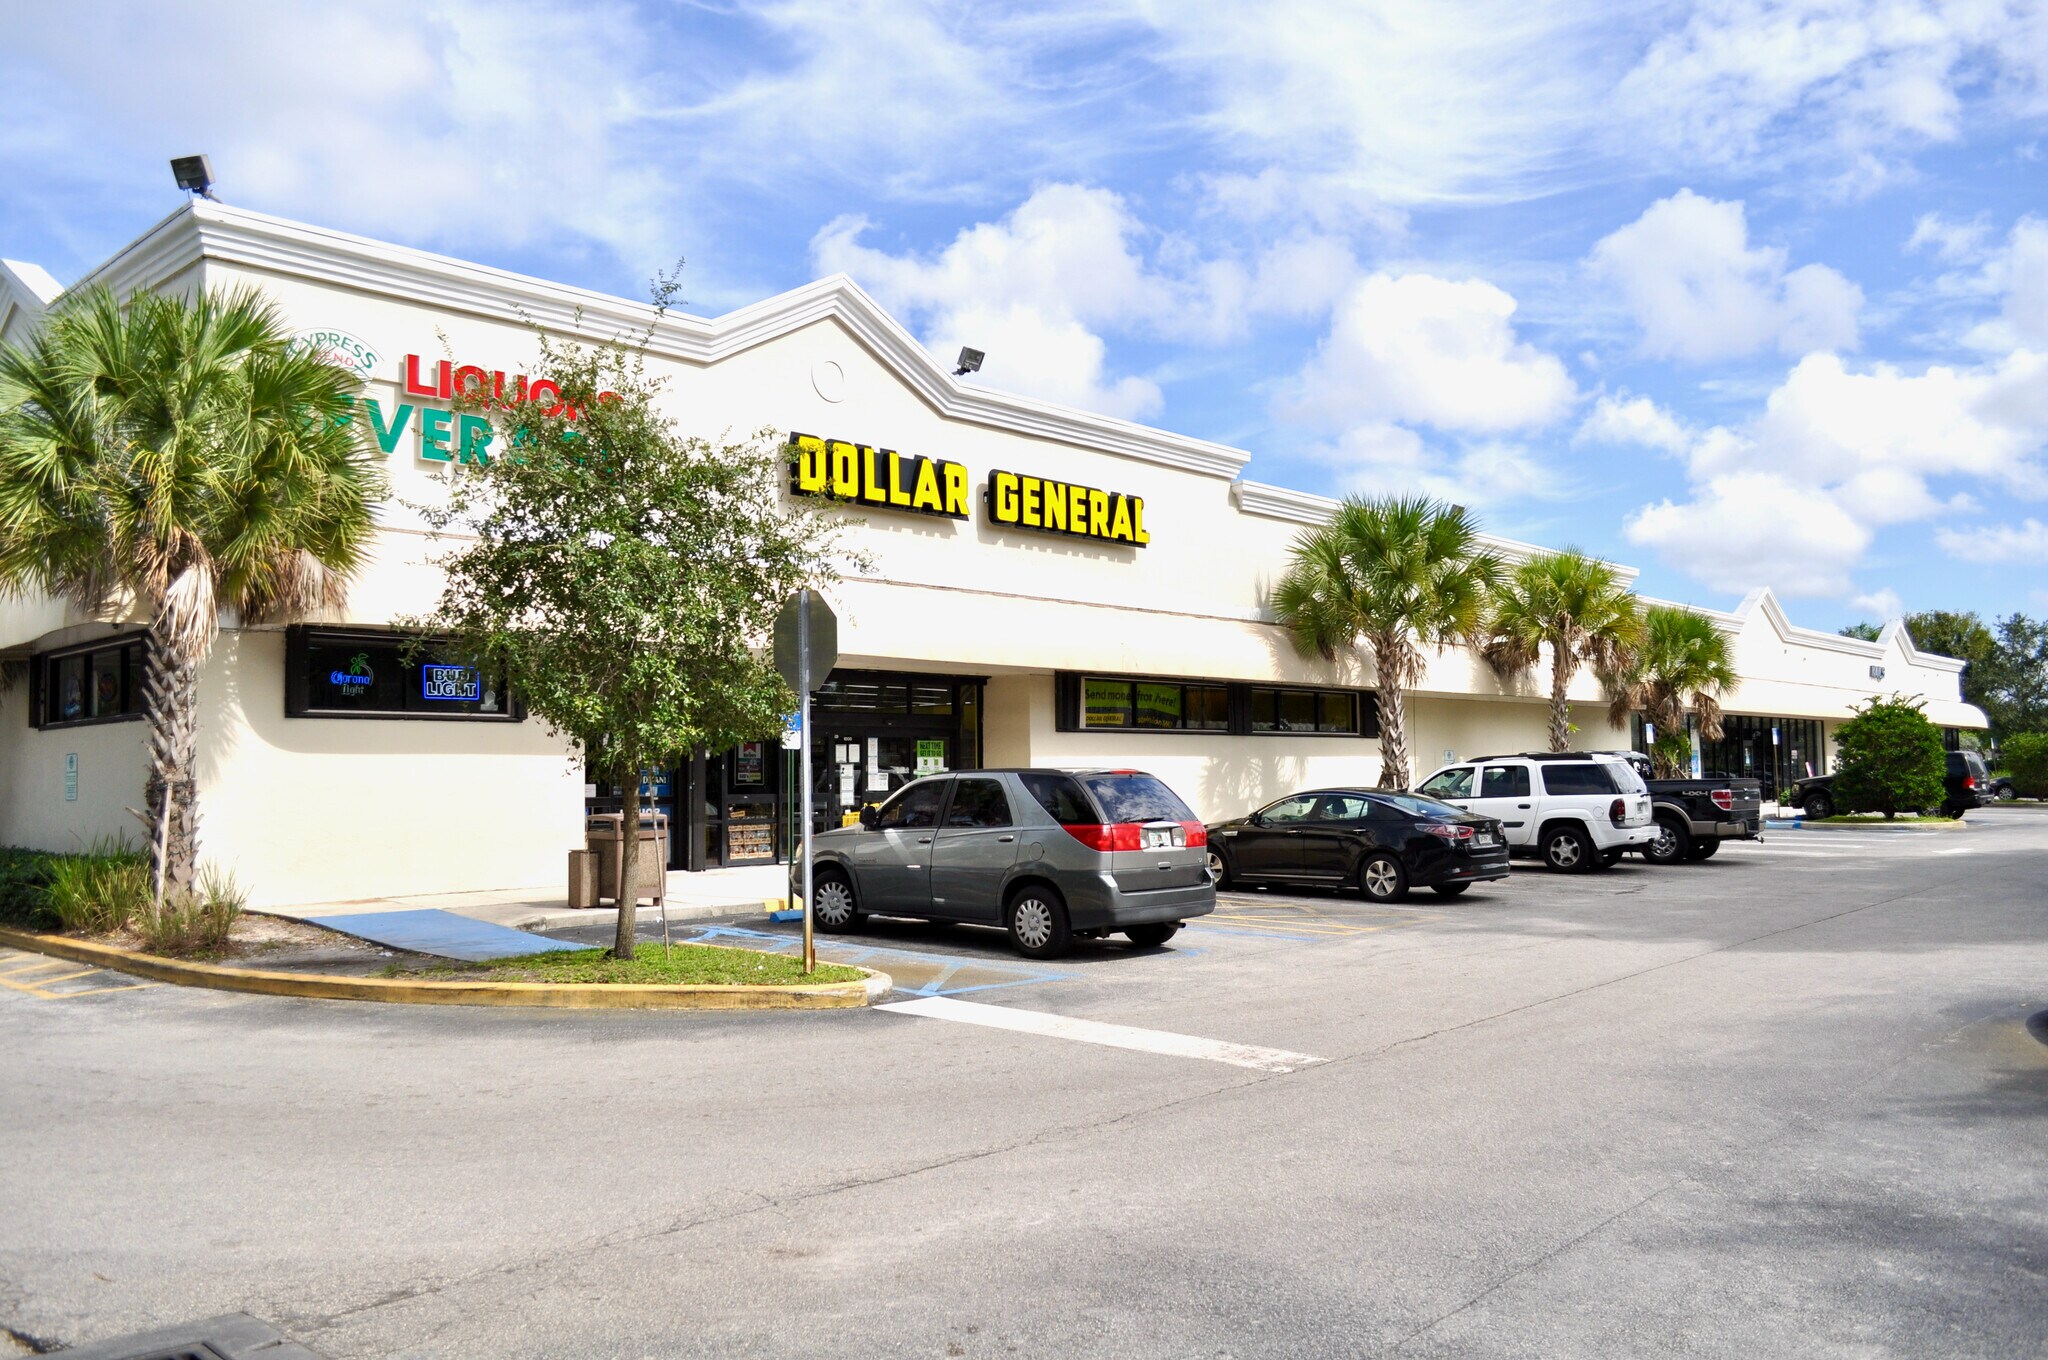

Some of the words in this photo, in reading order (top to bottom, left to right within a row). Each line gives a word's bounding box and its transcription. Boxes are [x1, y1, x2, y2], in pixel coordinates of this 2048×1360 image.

[314, 347, 355, 367] END
[404, 353, 625, 422] LIQUO
[797, 434, 970, 517] DOLLAR
[994, 471, 1150, 545] GENERAL
[331, 671, 370, 685] Corona
[1085, 688, 1107, 700] Send
[1107, 691, 1131, 701] mone
[642, 776, 667, 784] DANI
